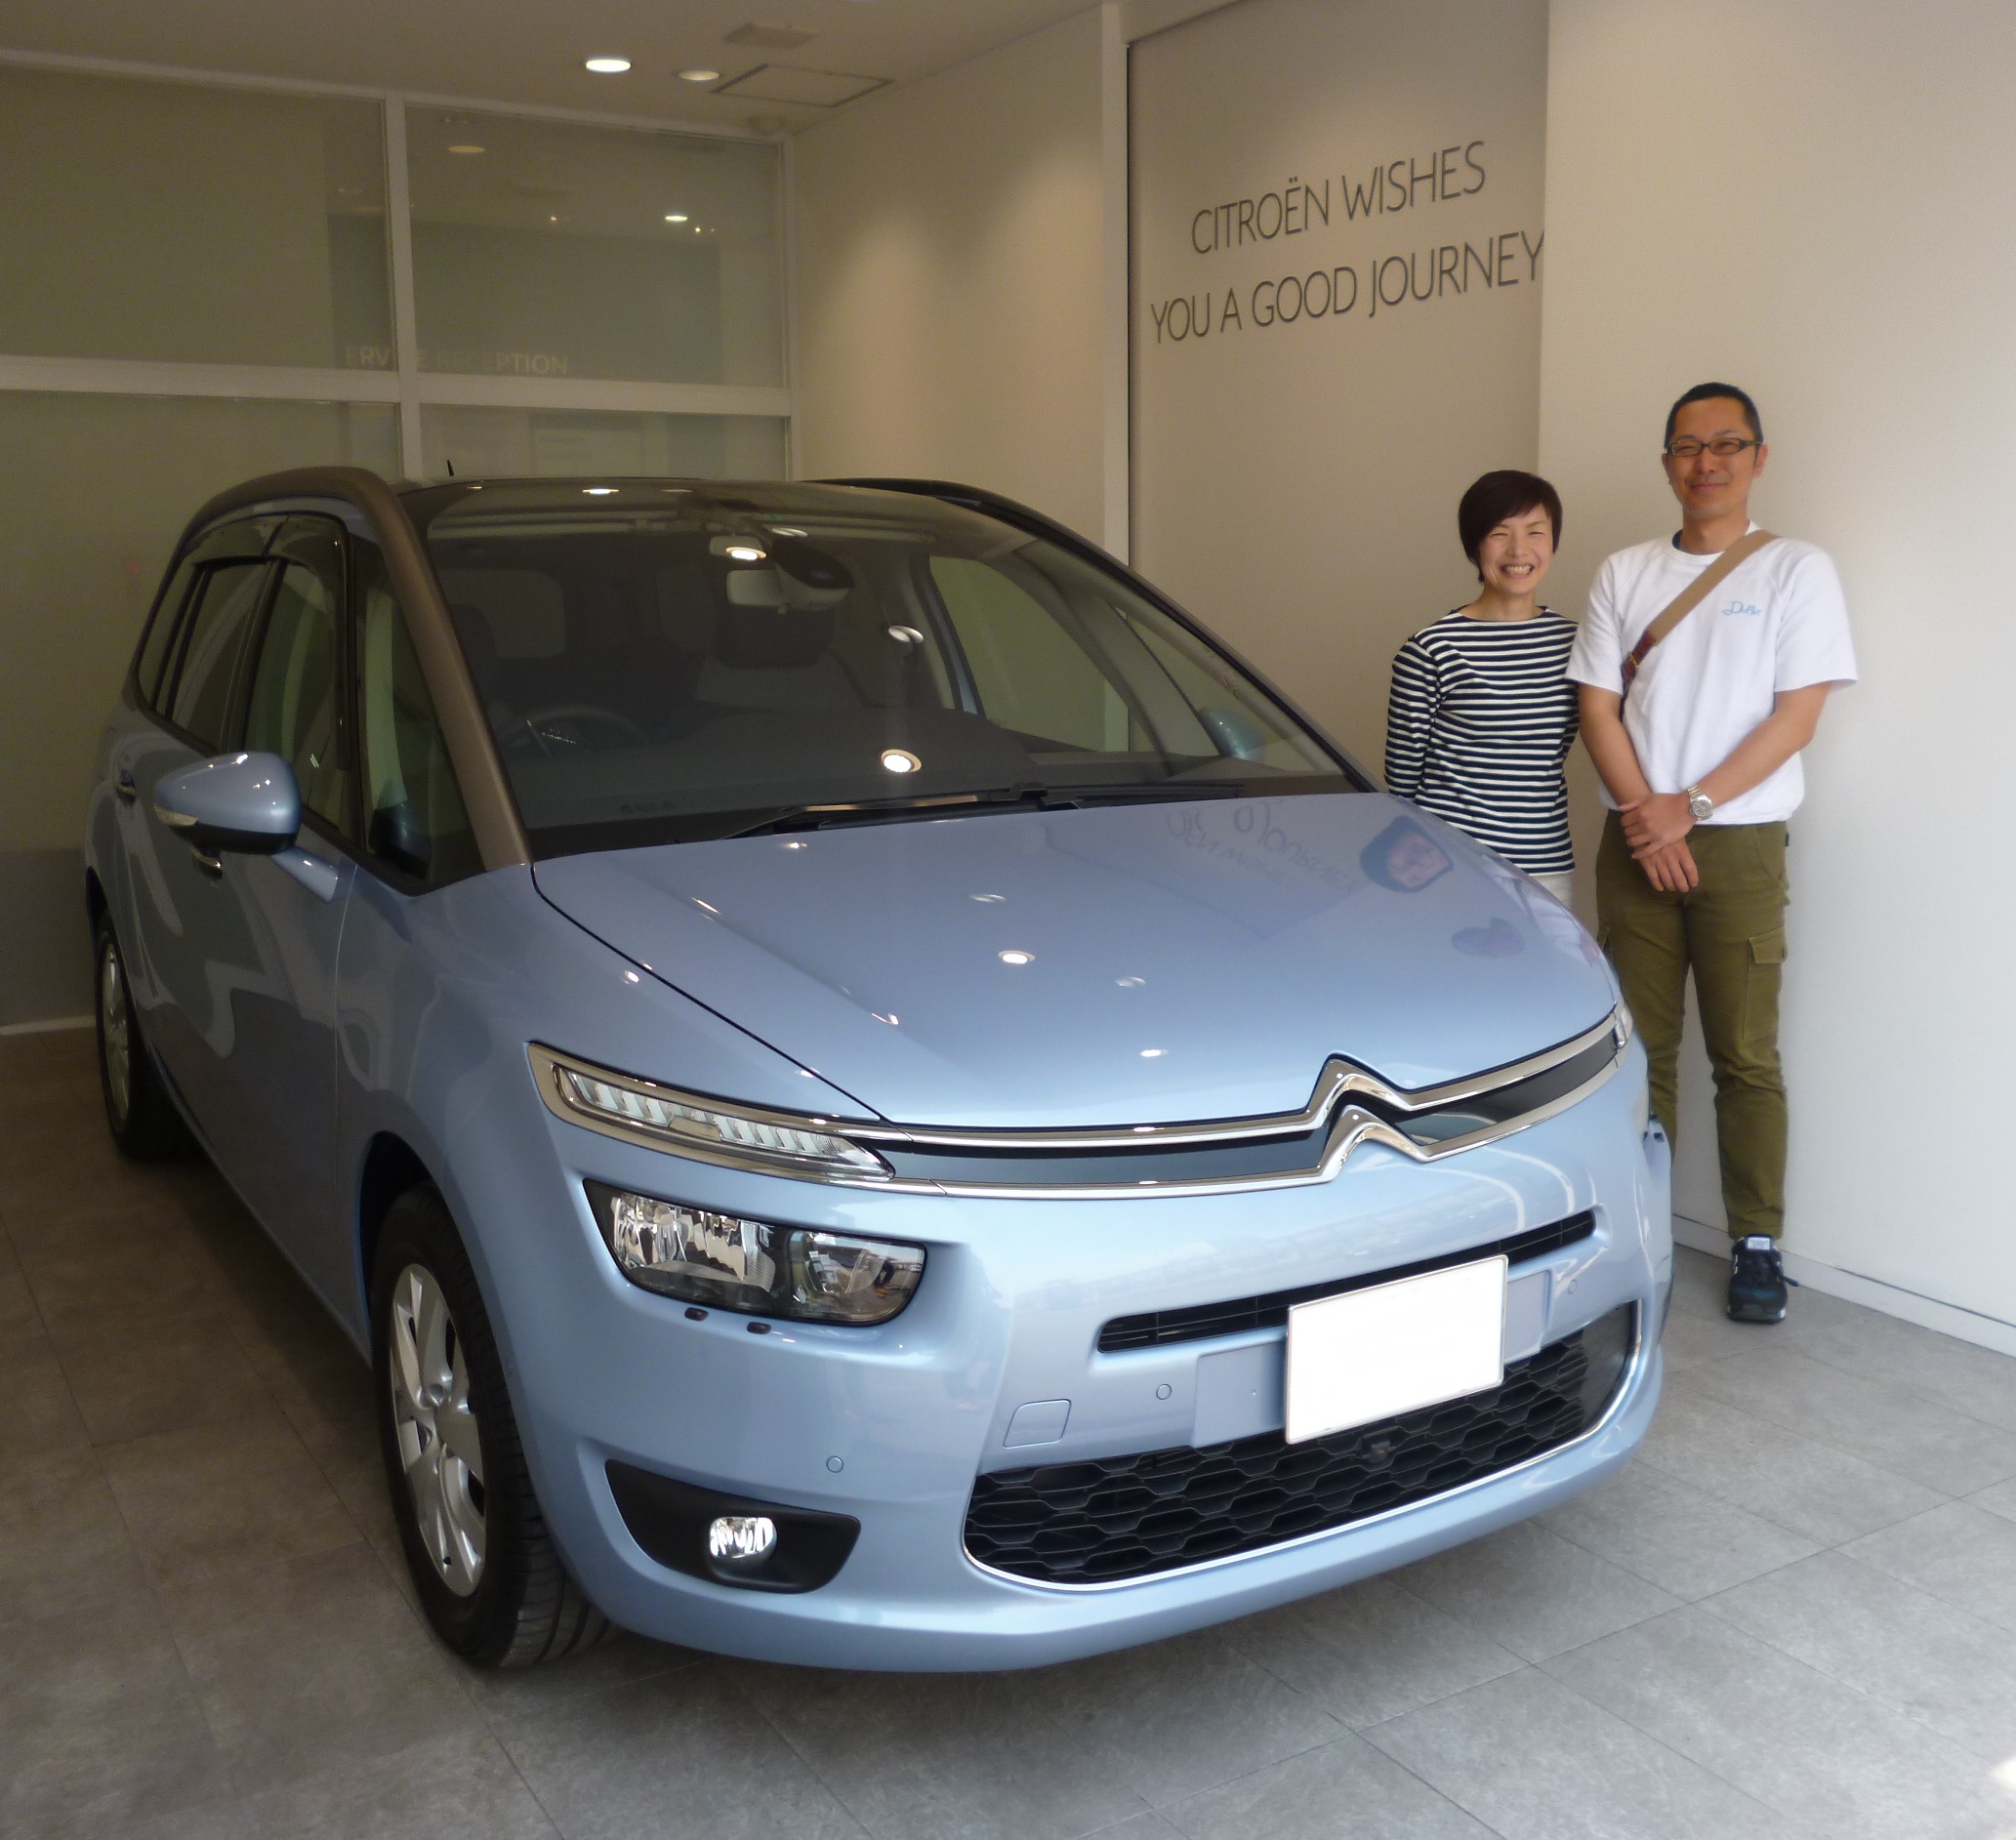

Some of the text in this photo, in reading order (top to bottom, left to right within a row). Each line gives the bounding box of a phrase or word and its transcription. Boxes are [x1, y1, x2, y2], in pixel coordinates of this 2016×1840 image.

[1191, 140, 1487, 255] CITROËN WISHES
[1150, 228, 1545, 345] YOU A GOOD JOURNEY
